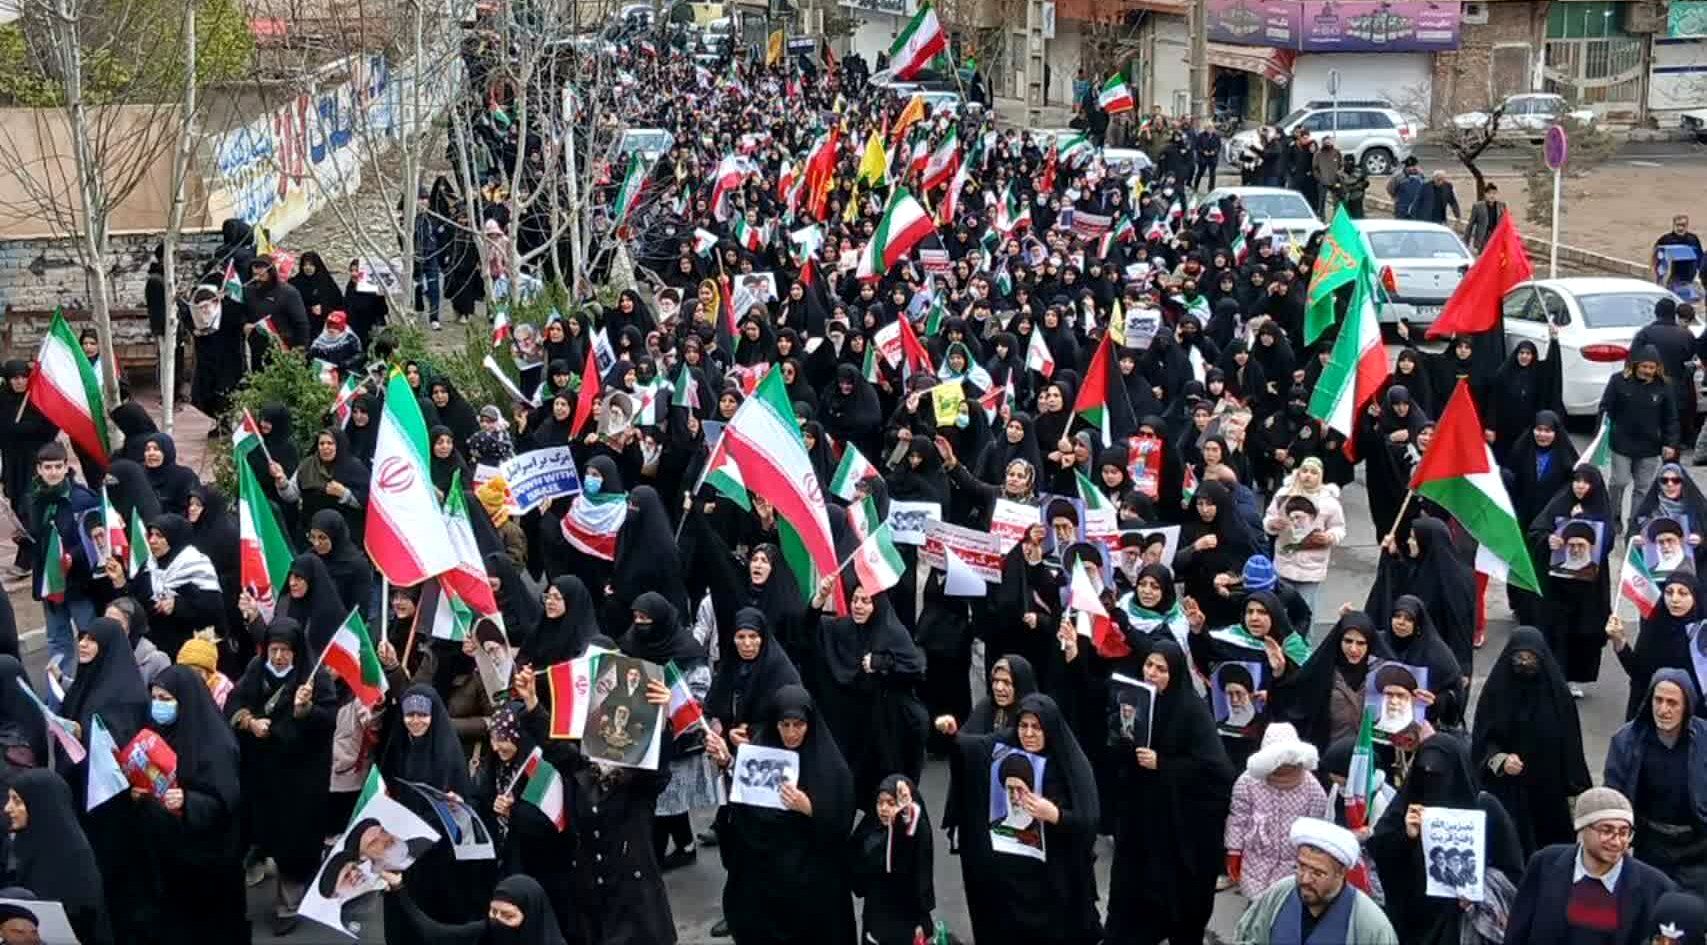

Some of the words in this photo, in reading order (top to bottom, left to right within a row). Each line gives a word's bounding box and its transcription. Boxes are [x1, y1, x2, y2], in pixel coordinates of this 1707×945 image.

[538, 457, 548, 471] بر
[549, 451, 569, 466] مرگ
[507, 456, 537, 483] اسرائیل
[512, 477, 544, 495] DOWN
[543, 470, 576, 484] WITH
[526, 483, 560, 502] ISRAEL
